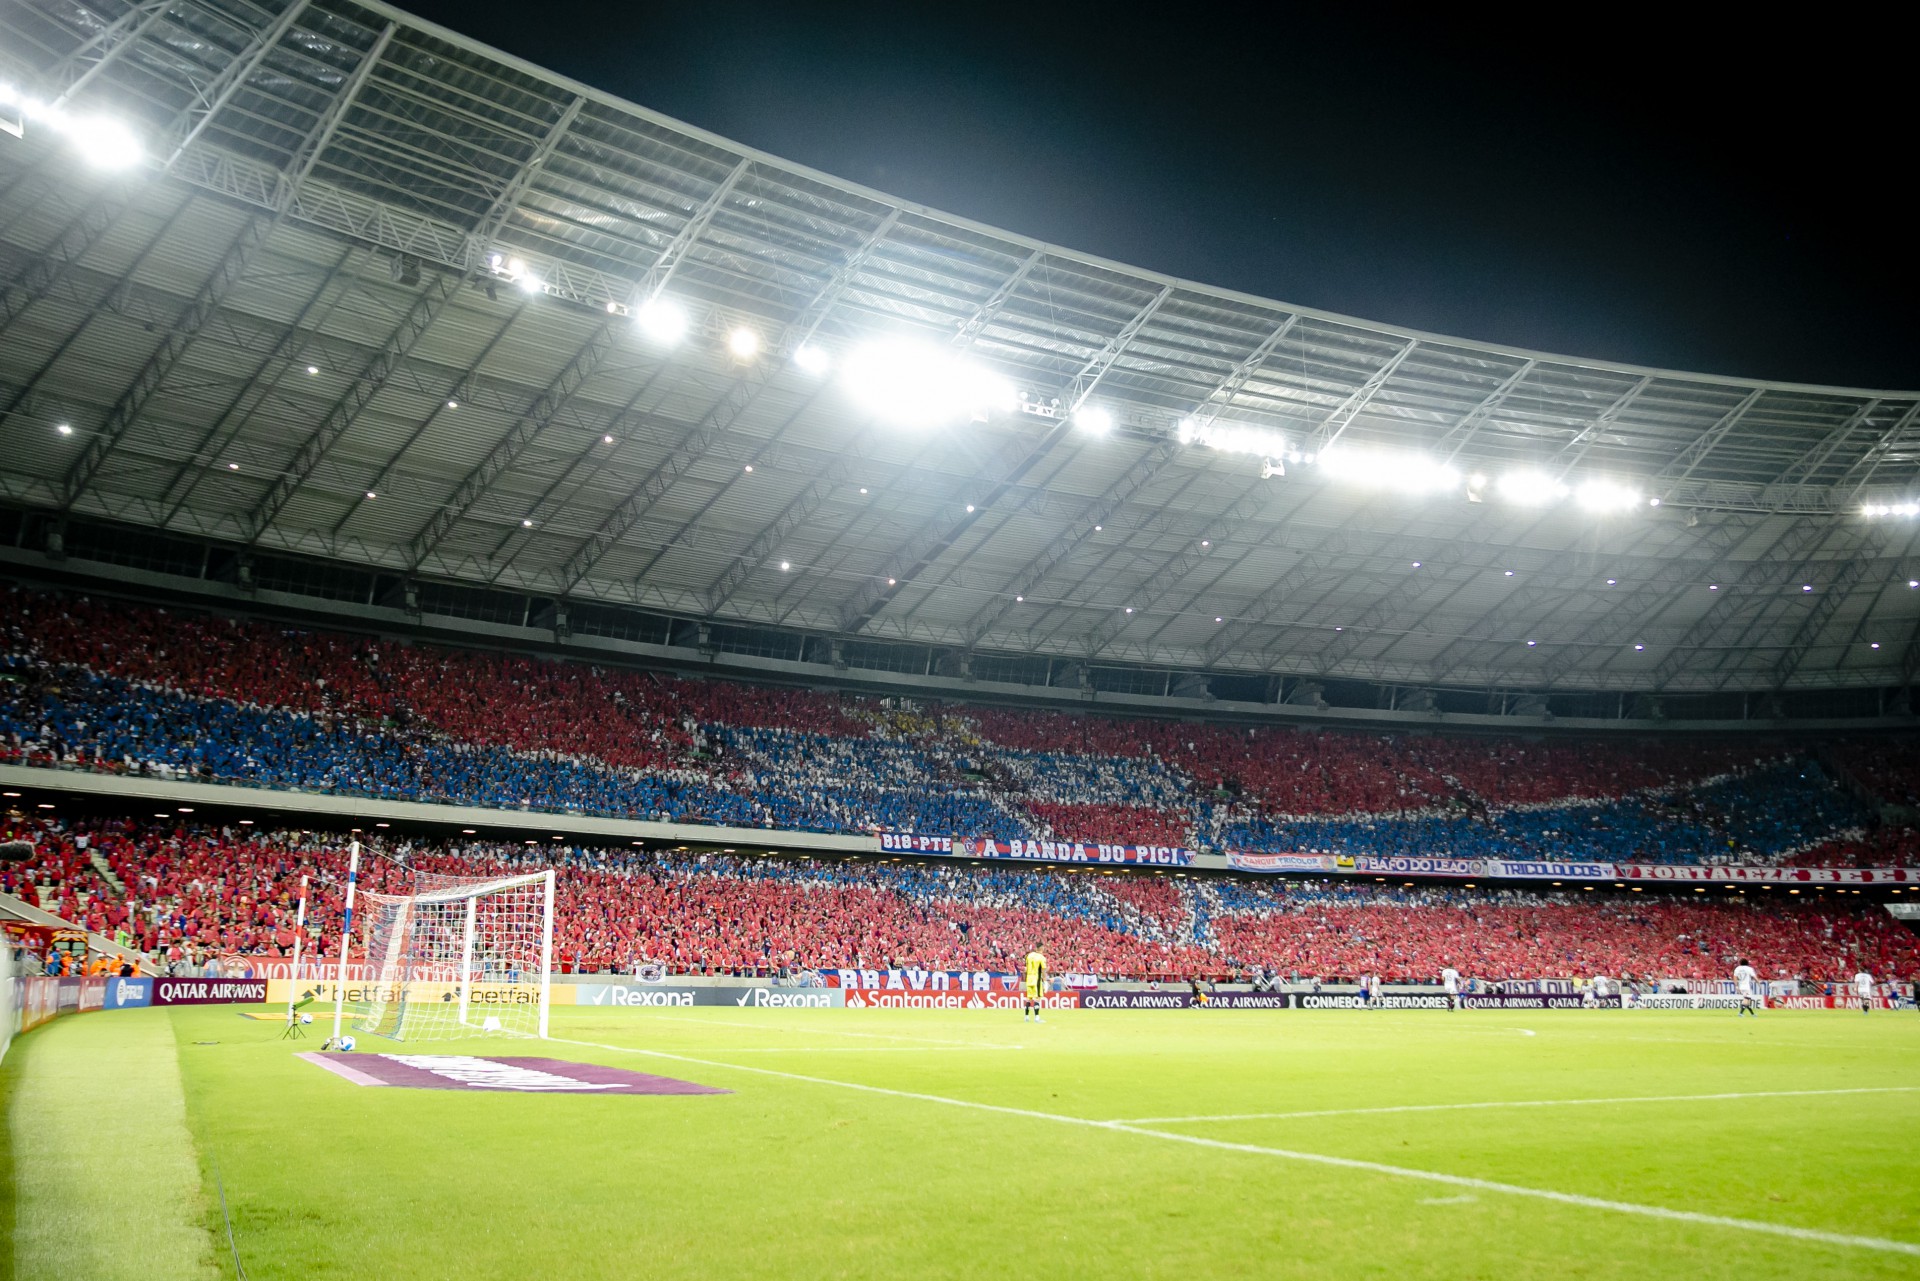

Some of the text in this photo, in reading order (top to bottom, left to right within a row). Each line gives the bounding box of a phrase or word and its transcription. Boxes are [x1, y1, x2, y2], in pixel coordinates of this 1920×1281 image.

[882, 834, 951, 852] B18-PTE
[983, 838, 1178, 865] A BANDA DO PICI
[1279, 856, 1318, 866] TRICOLOR
[1369, 859, 1407, 872] BAFO
[1409, 860, 1431, 871] DO
[1500, 862, 1602, 877] TRICOLOUCOS
[1639, 865, 1801, 881] FORTALEZA
[159, 983, 266, 1002] QATAR AIRWAYS
[611, 985, 696, 1007] Rexona
[761, 987, 833, 1008] Rexona
[867, 990, 965, 1008] Santander
[986, 991, 1078, 1009] Santnder
[1085, 996, 1182, 1009] QATAR AIRWAYS
[1232, 996, 1281, 1008] AIRWAYS
[1302, 996, 1368, 1009] CONMEBOL
[1468, 998, 1544, 1009] QATAR AIRWAYS
[1548, 998, 1580, 1010] QATAR
[1698, 998, 1761, 1009] BRIDGESTNE
[1786, 997, 1826, 1009] AMSTEL
[1846, 997, 1885, 1009] AMTEL
